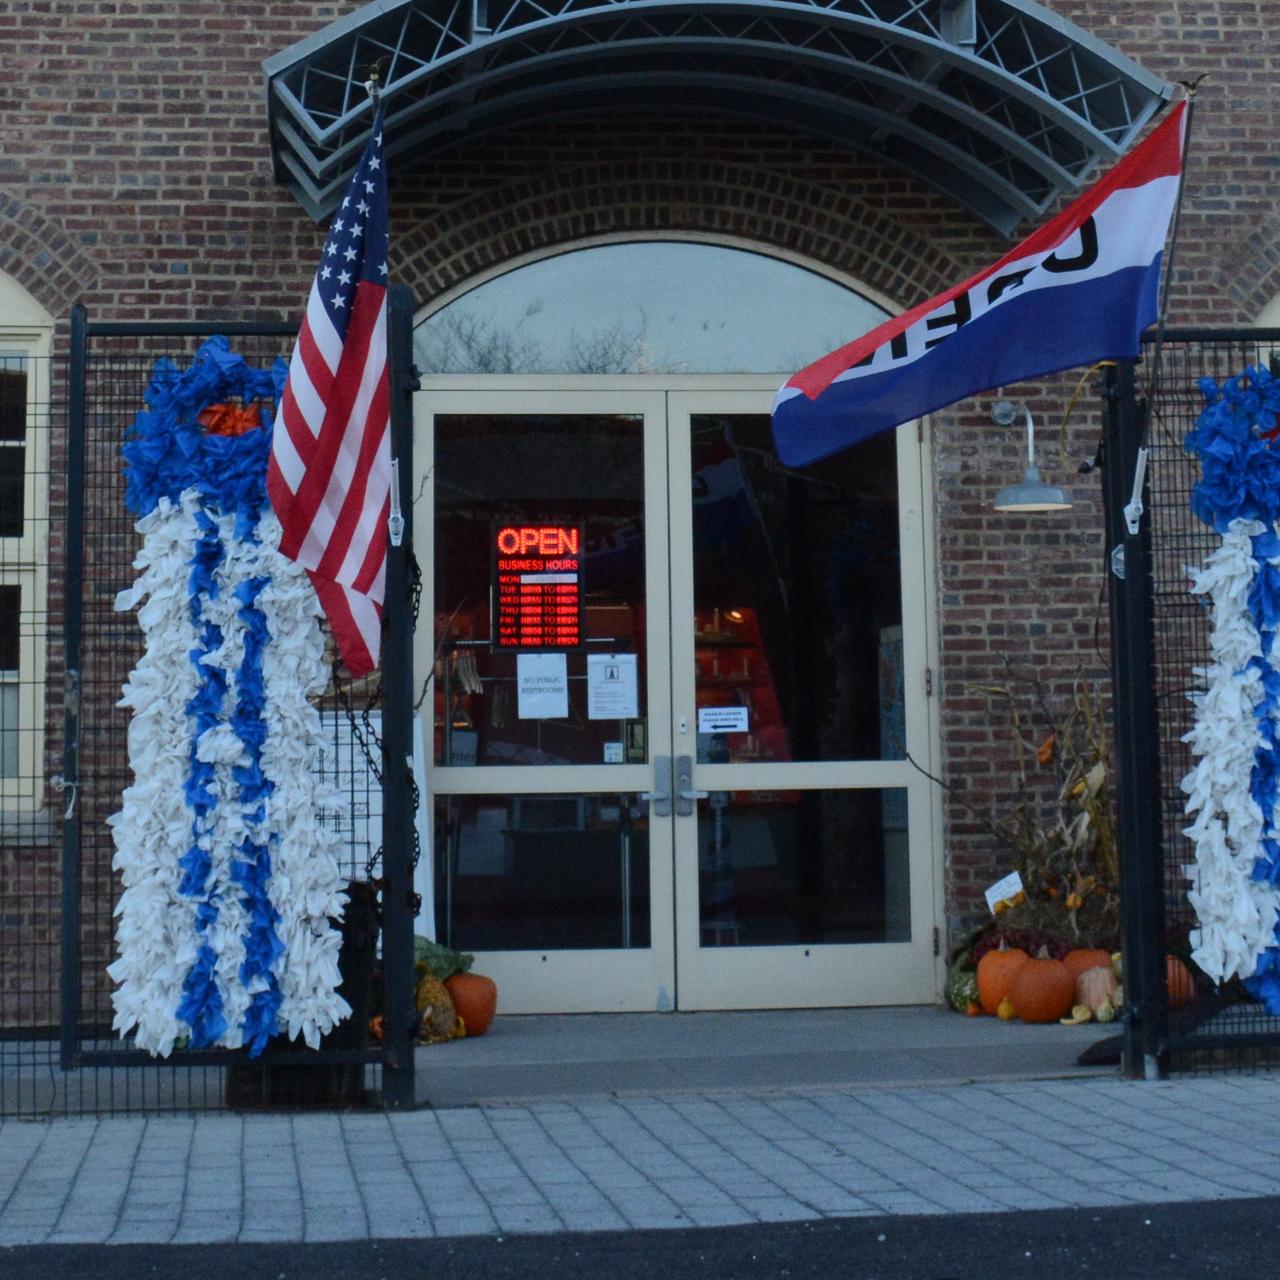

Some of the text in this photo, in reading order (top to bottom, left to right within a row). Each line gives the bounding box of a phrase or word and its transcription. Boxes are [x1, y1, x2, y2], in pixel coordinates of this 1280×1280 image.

[498, 528, 578, 555] OPEN
[499, 559, 578, 571] BUSINESS HOURS
[499, 575, 520, 583] MON
